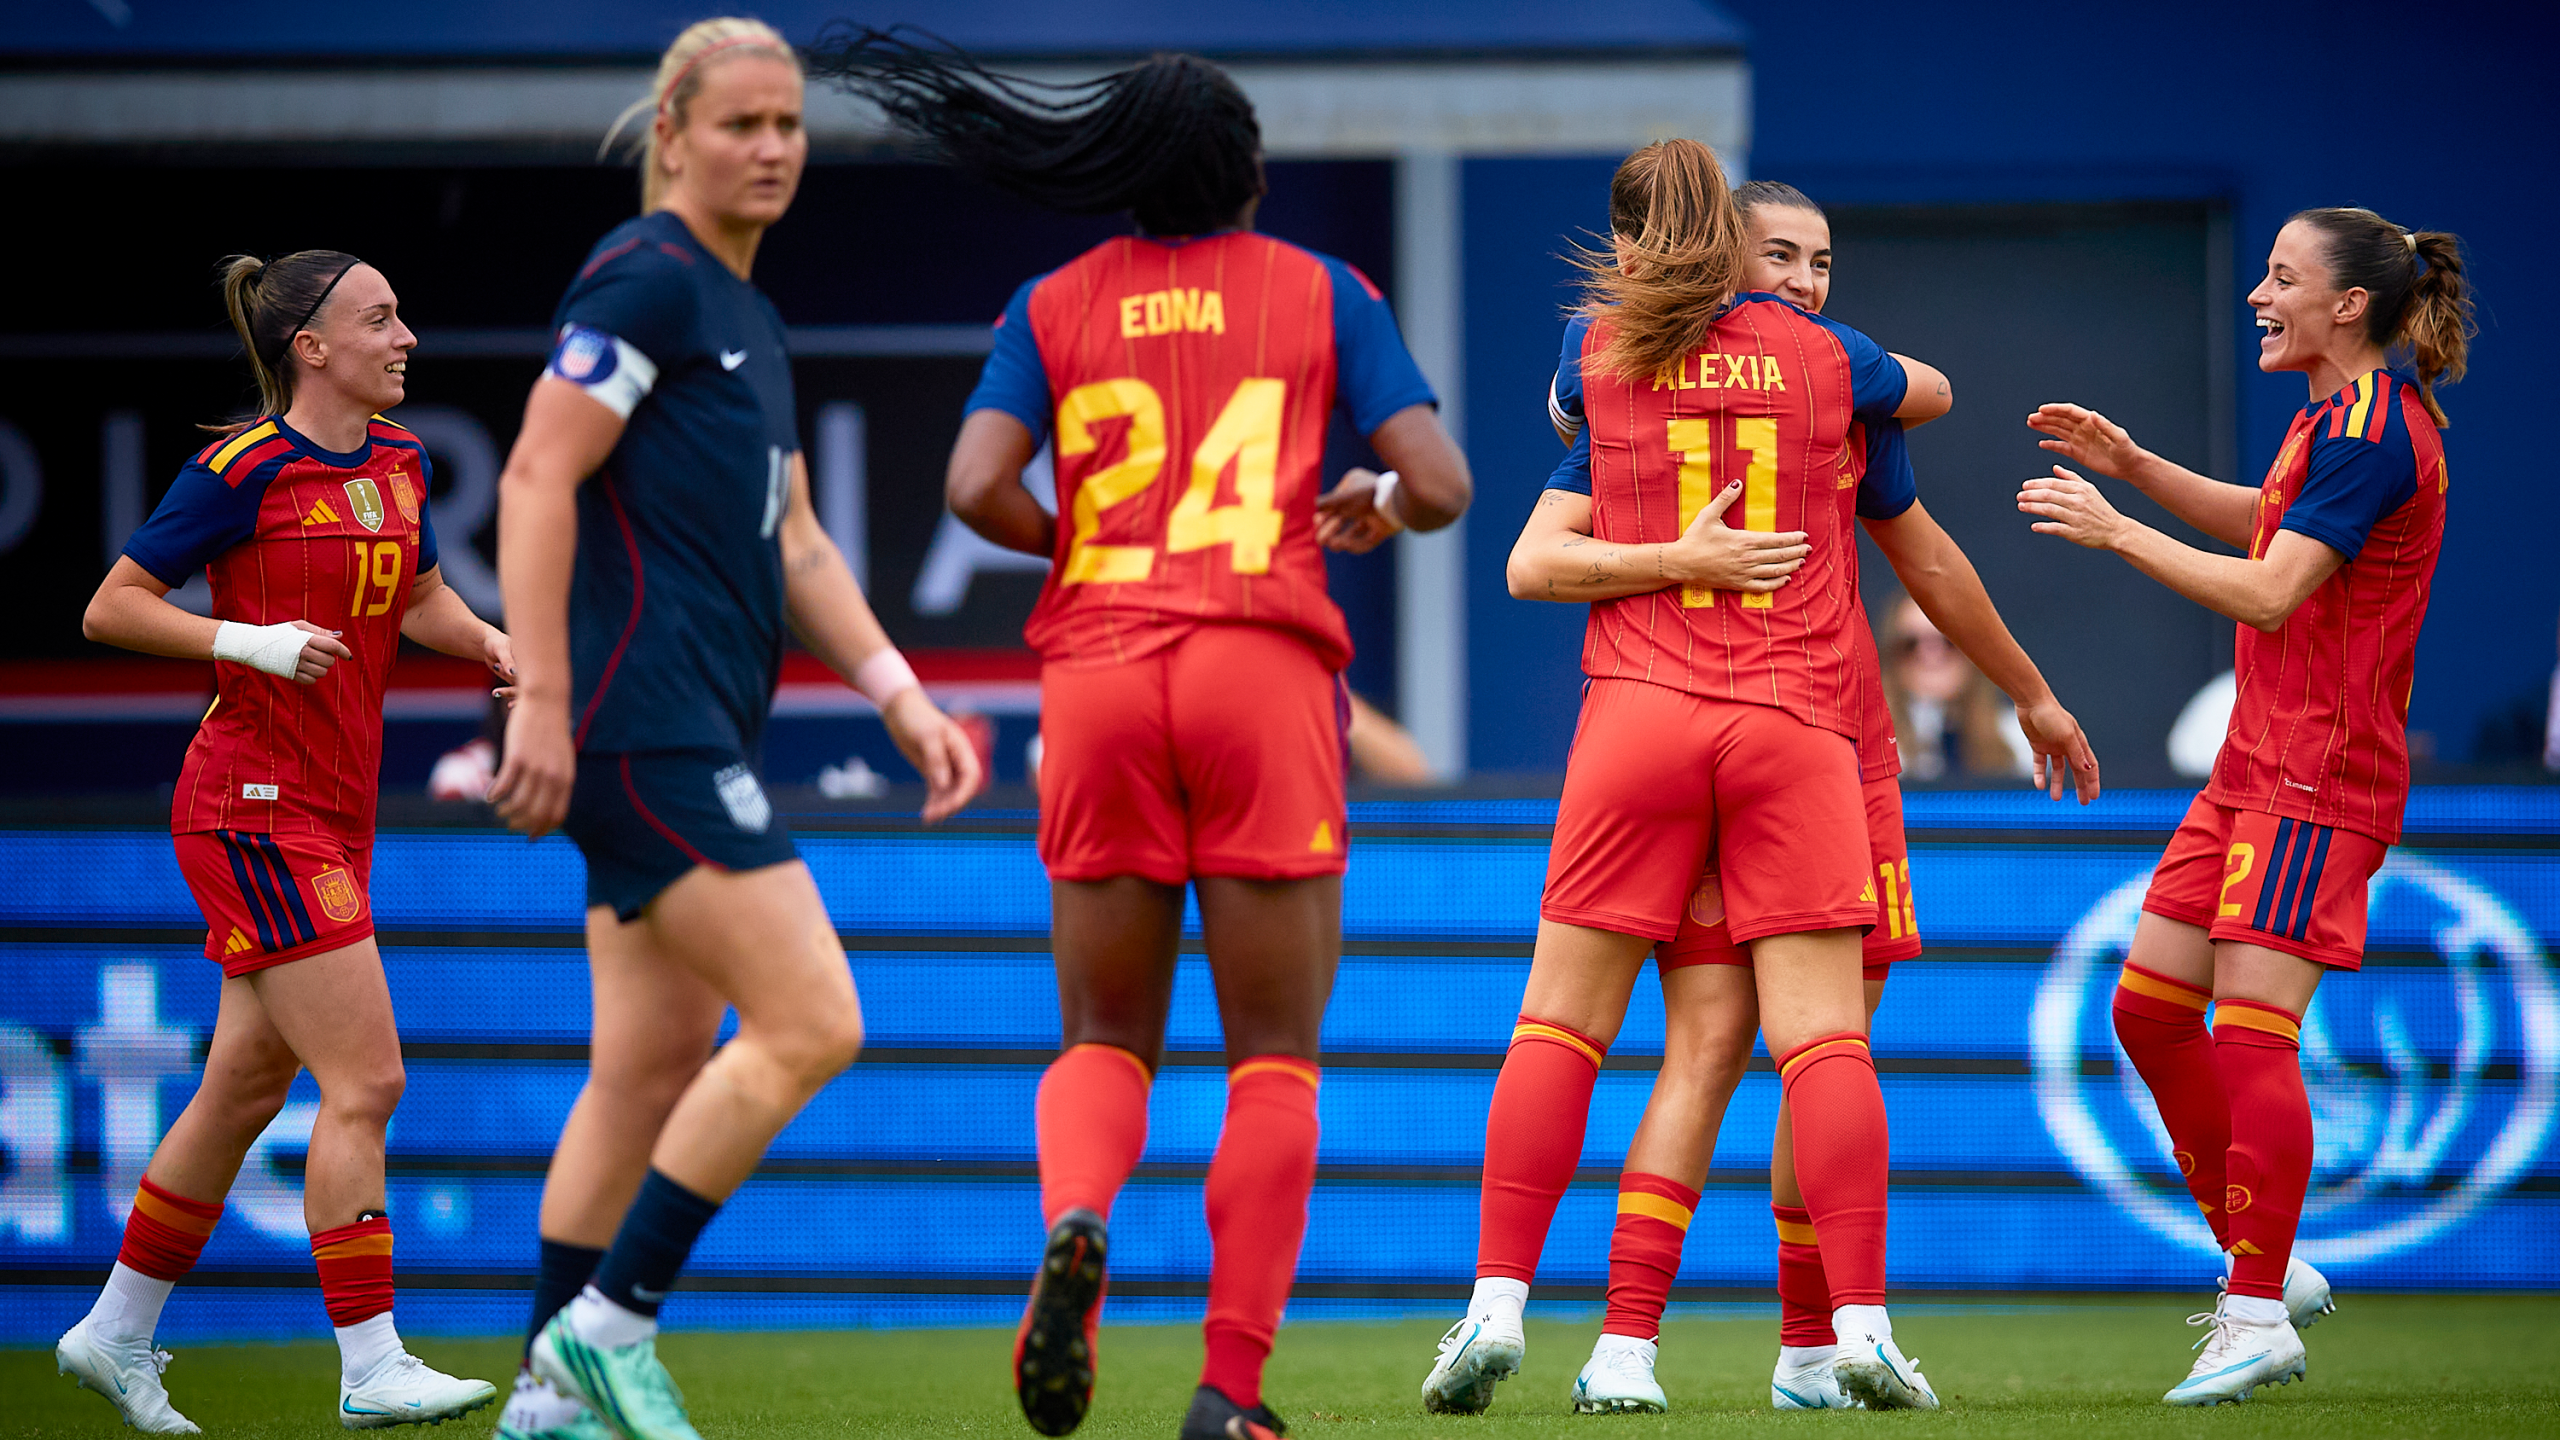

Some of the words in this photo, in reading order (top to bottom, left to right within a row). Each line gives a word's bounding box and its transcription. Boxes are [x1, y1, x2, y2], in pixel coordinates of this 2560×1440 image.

[1120, 287, 1225, 338] EDNA
[1652, 354, 1786, 391] ALEXIA
[1058, 376, 1286, 588] 24
[1666, 418, 1778, 609] 11
[350, 541, 402, 617] 19
[2218, 842, 2255, 917] 2
